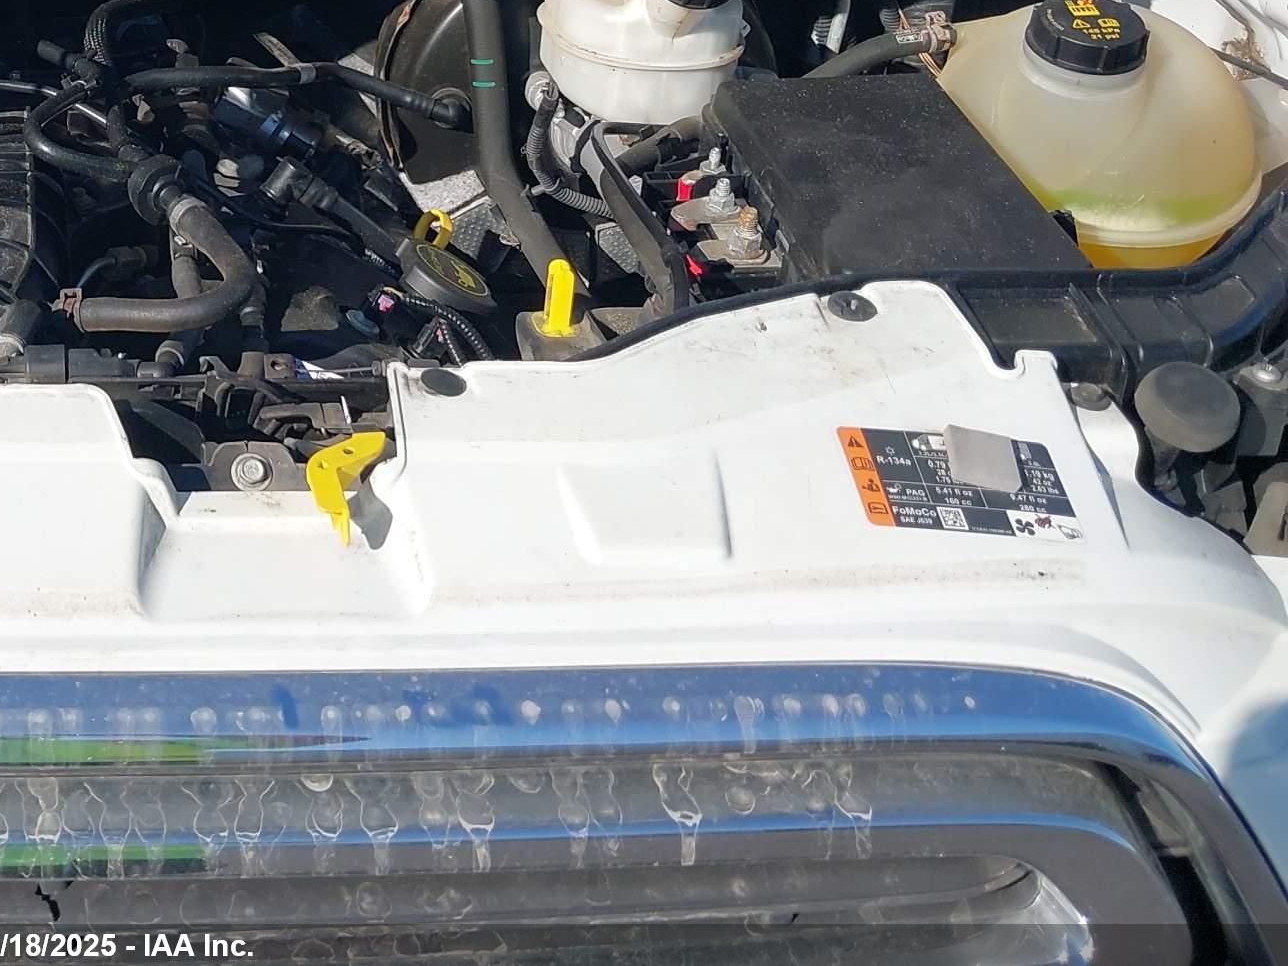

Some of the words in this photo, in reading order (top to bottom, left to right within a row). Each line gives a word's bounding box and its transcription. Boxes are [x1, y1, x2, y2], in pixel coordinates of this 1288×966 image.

[876, 455, 912, 466] R-134a
[927, 459, 946, 468] 0.79
[1042, 471, 1055, 481] kg
[905, 487, 926, 497] PAG
[892, 505, 937, 517] FoMoCo
